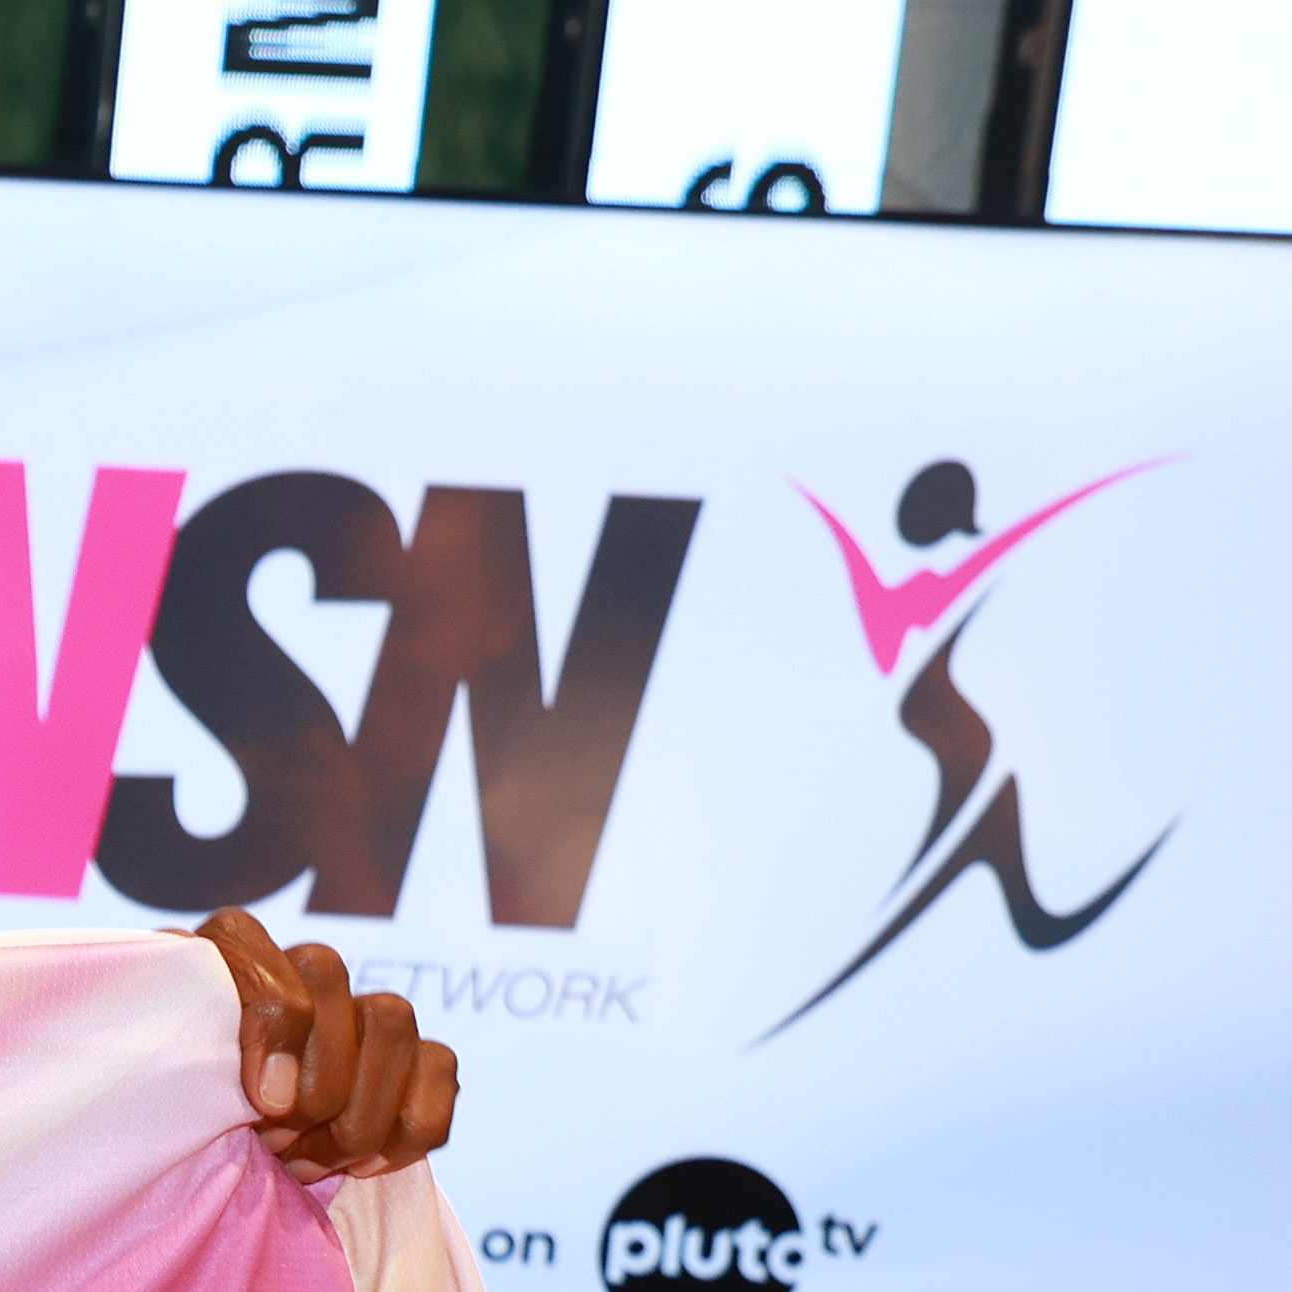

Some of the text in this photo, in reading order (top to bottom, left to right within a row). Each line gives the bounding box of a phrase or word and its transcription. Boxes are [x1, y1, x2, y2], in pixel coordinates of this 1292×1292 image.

[346, 958, 651, 1025] ETWORK
[481, 1228, 556, 1265] on
[821, 1214, 878, 1257] tv
